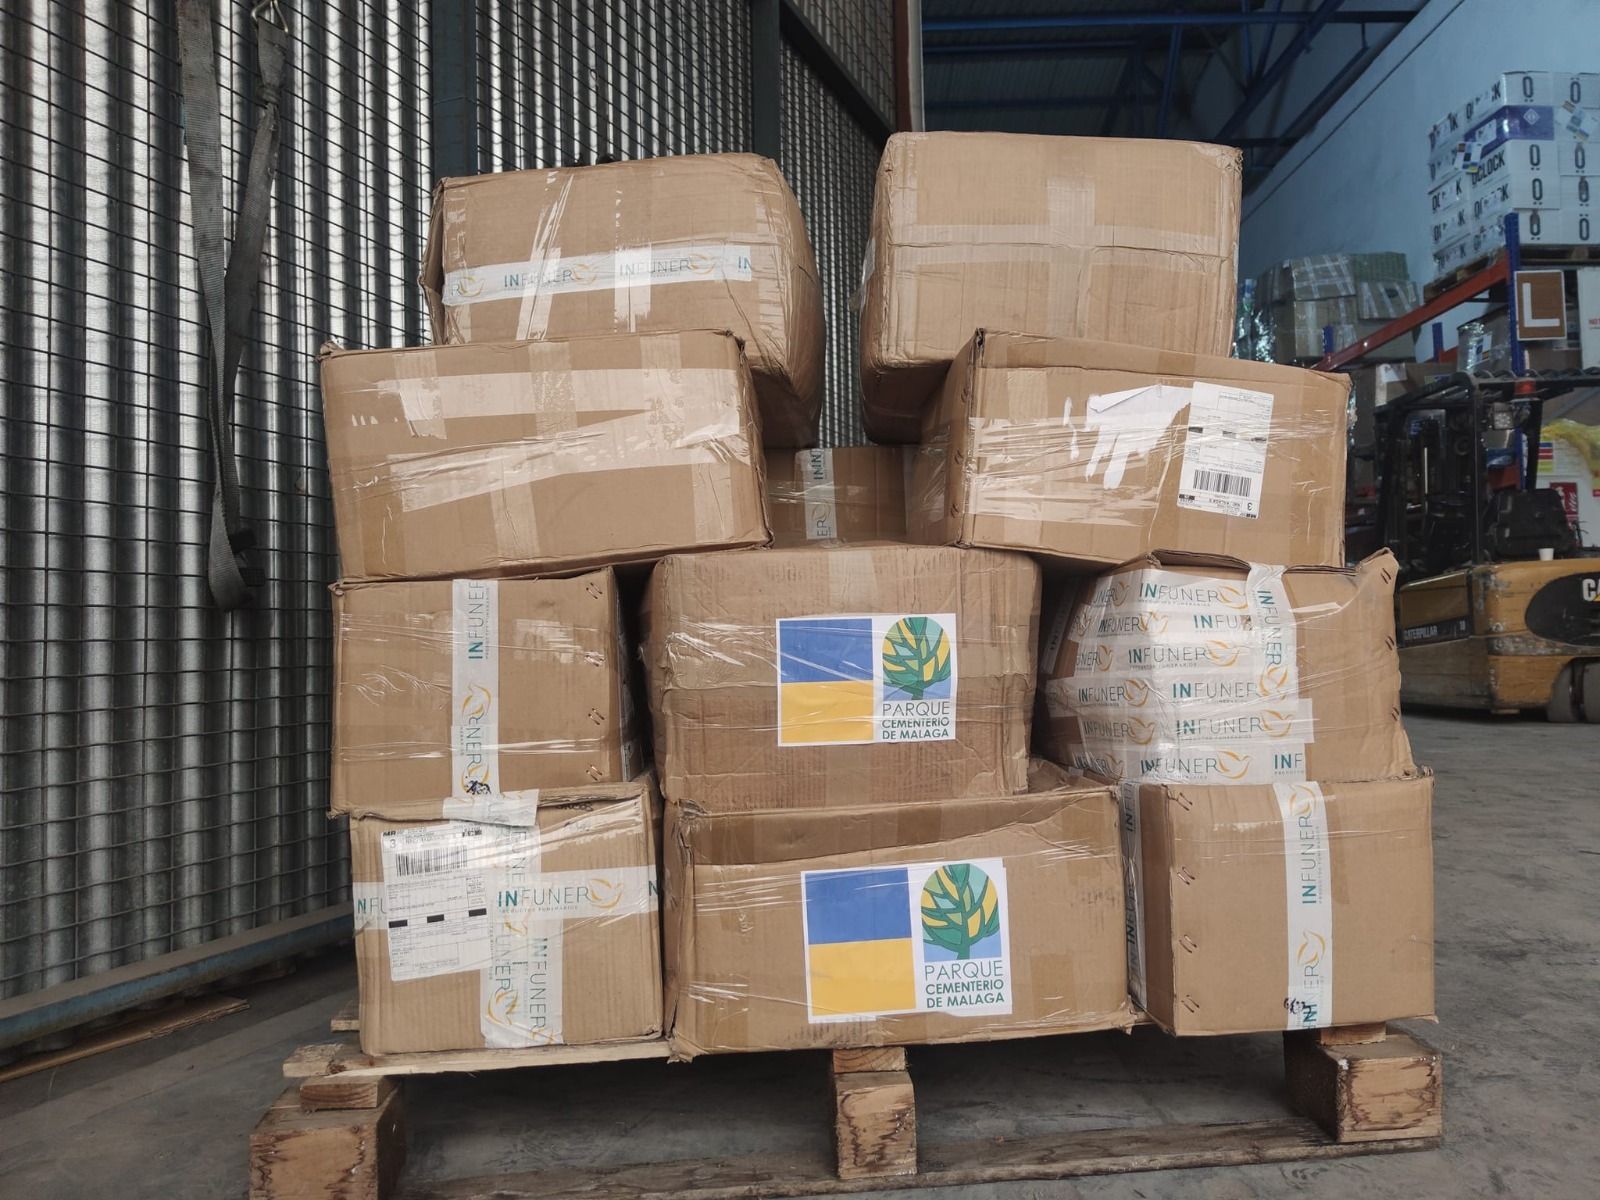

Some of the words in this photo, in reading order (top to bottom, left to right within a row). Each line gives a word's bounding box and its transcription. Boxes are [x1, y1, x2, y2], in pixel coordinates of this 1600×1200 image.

[1522, 282, 1560, 328] L
[1139, 583, 1222, 604] INFUNER
[1257, 590, 1282, 669] INFUNER
[1128, 646, 1210, 664] INFUNER
[1078, 686, 1127, 702] INFUNER
[1172, 682, 1262, 699] INFUNER
[882, 701, 951, 717] PARQUE
[881, 717, 950, 729] CEMENTERIO
[1176, 716, 1265, 736] INFUNER
[882, 730, 897, 740] DE
[900, 728, 949, 739] MALAGA
[1299, 812, 1318, 904] INFUNER
[498, 885, 593, 907] INFUNER
[924, 960, 1004, 981] PARQUE
[529, 938, 548, 1032] INFUNER
[925, 979, 1004, 995] CEMENTERIO
[927, 997, 942, 1009] DE
[947, 992, 1005, 1007] MALAGA
